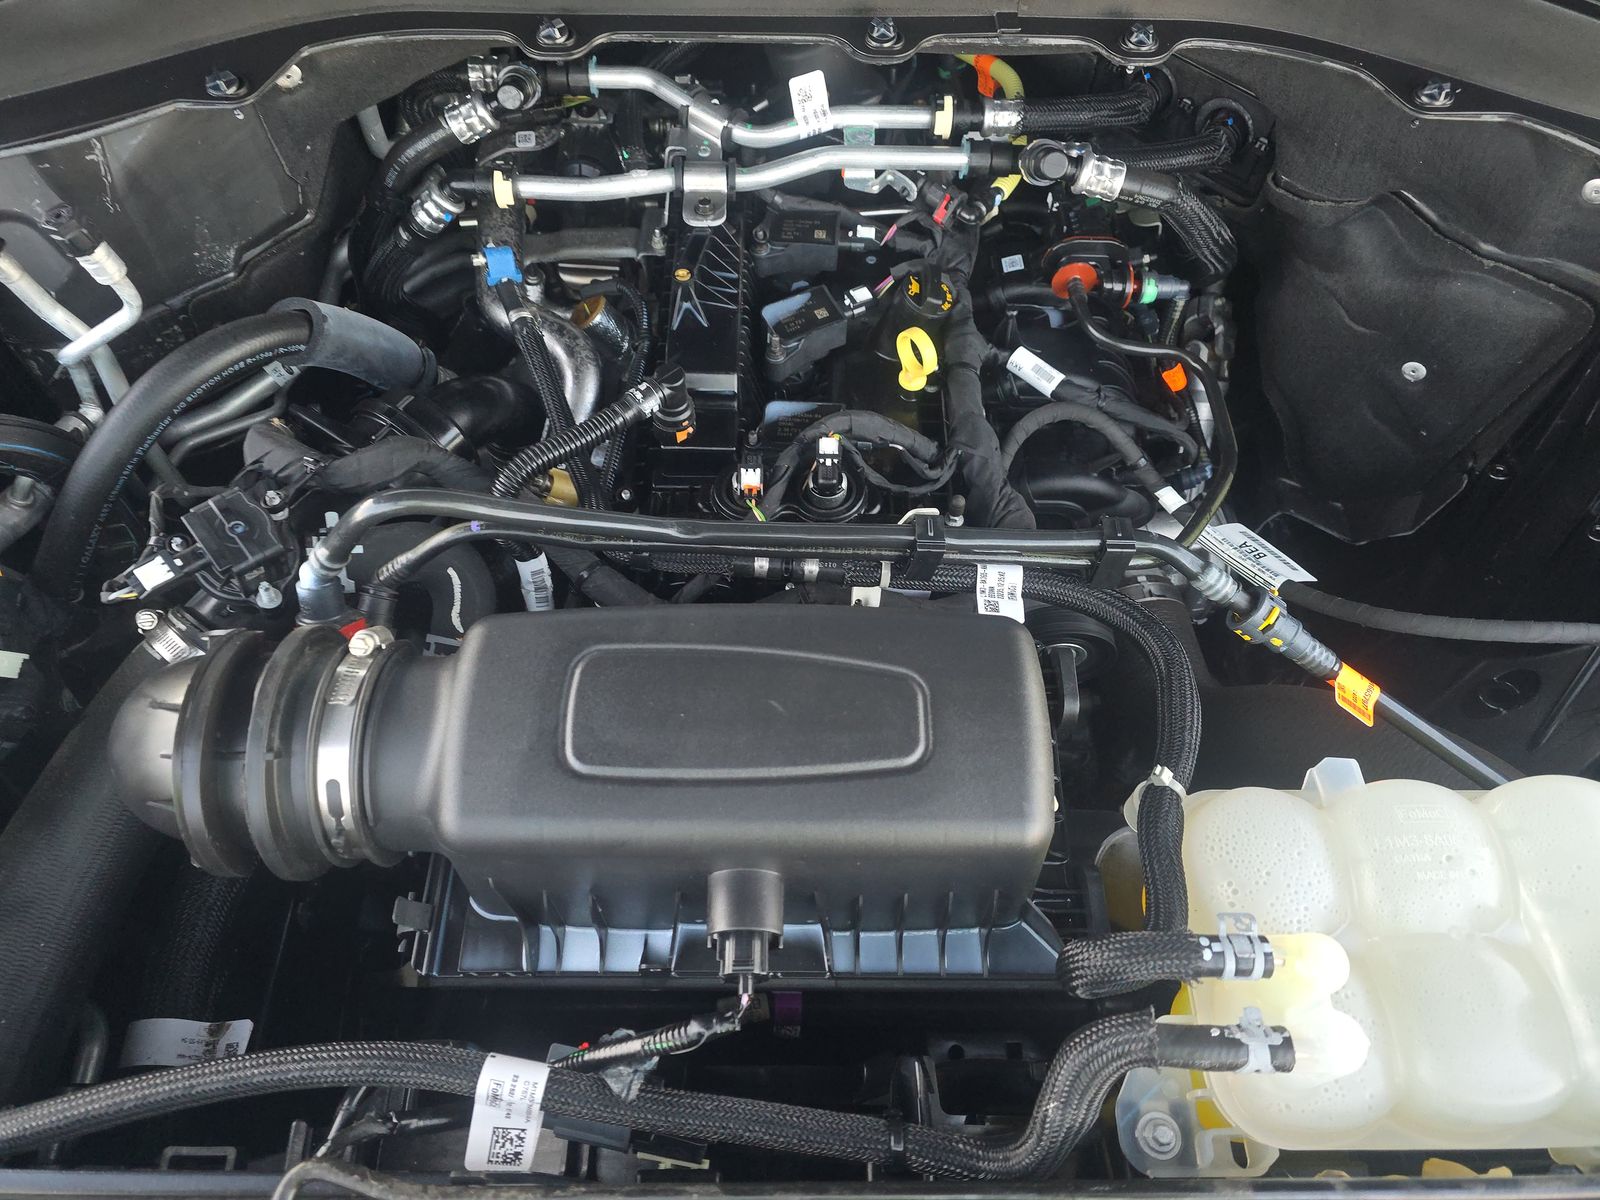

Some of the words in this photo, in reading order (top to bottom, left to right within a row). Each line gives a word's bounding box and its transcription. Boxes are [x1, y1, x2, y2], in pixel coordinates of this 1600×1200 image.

[186, 374, 222, 404] SUCTION
[221, 361, 247, 378] HOSE
[1239, 540, 1268, 560] BEA
